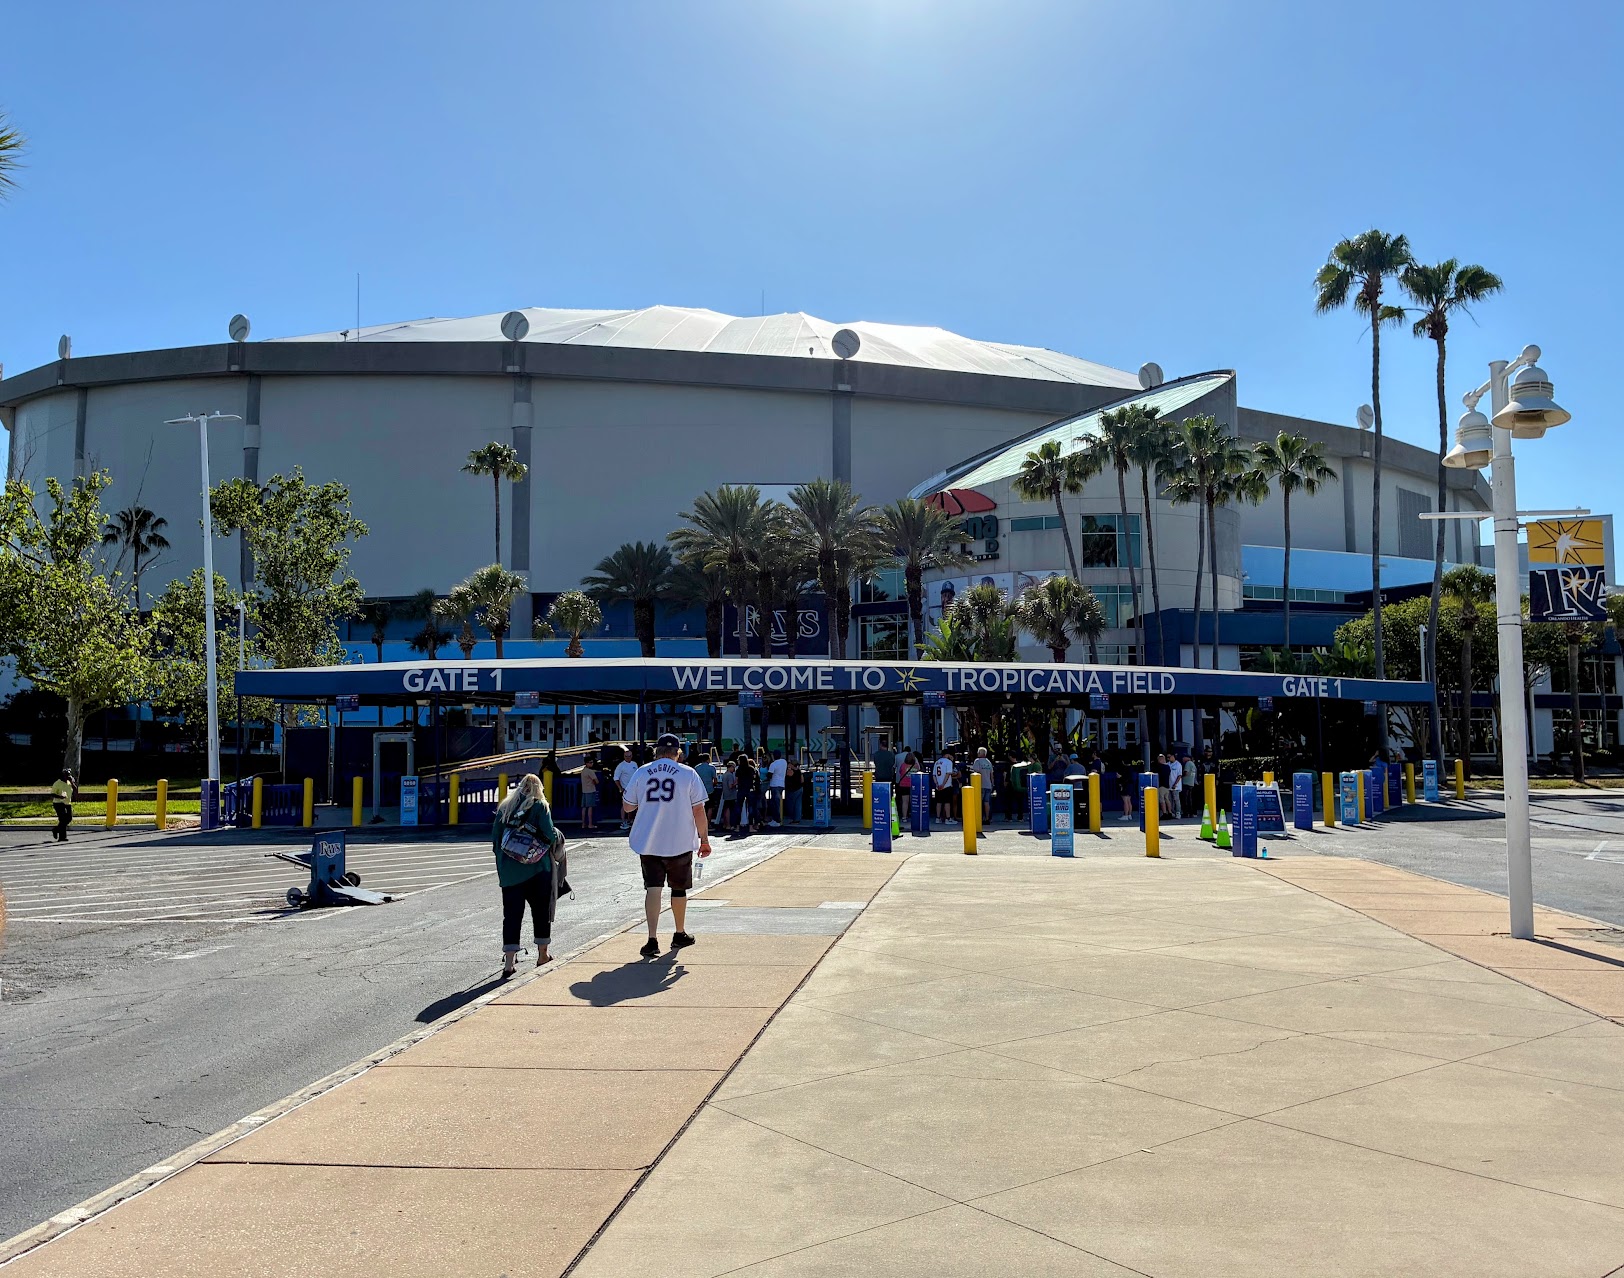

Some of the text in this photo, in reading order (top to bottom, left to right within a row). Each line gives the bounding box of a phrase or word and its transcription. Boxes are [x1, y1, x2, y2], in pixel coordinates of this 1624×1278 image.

[403, 668, 502, 692] GATE 1
[671, 666, 1176, 694] WELCOME TO TROPICANA FIELD
[1282, 676, 1342, 698] GATE 1
[646, 763, 680, 776] McGRIFF
[936, 766, 942, 777] 6
[645, 777, 675, 802] 29
